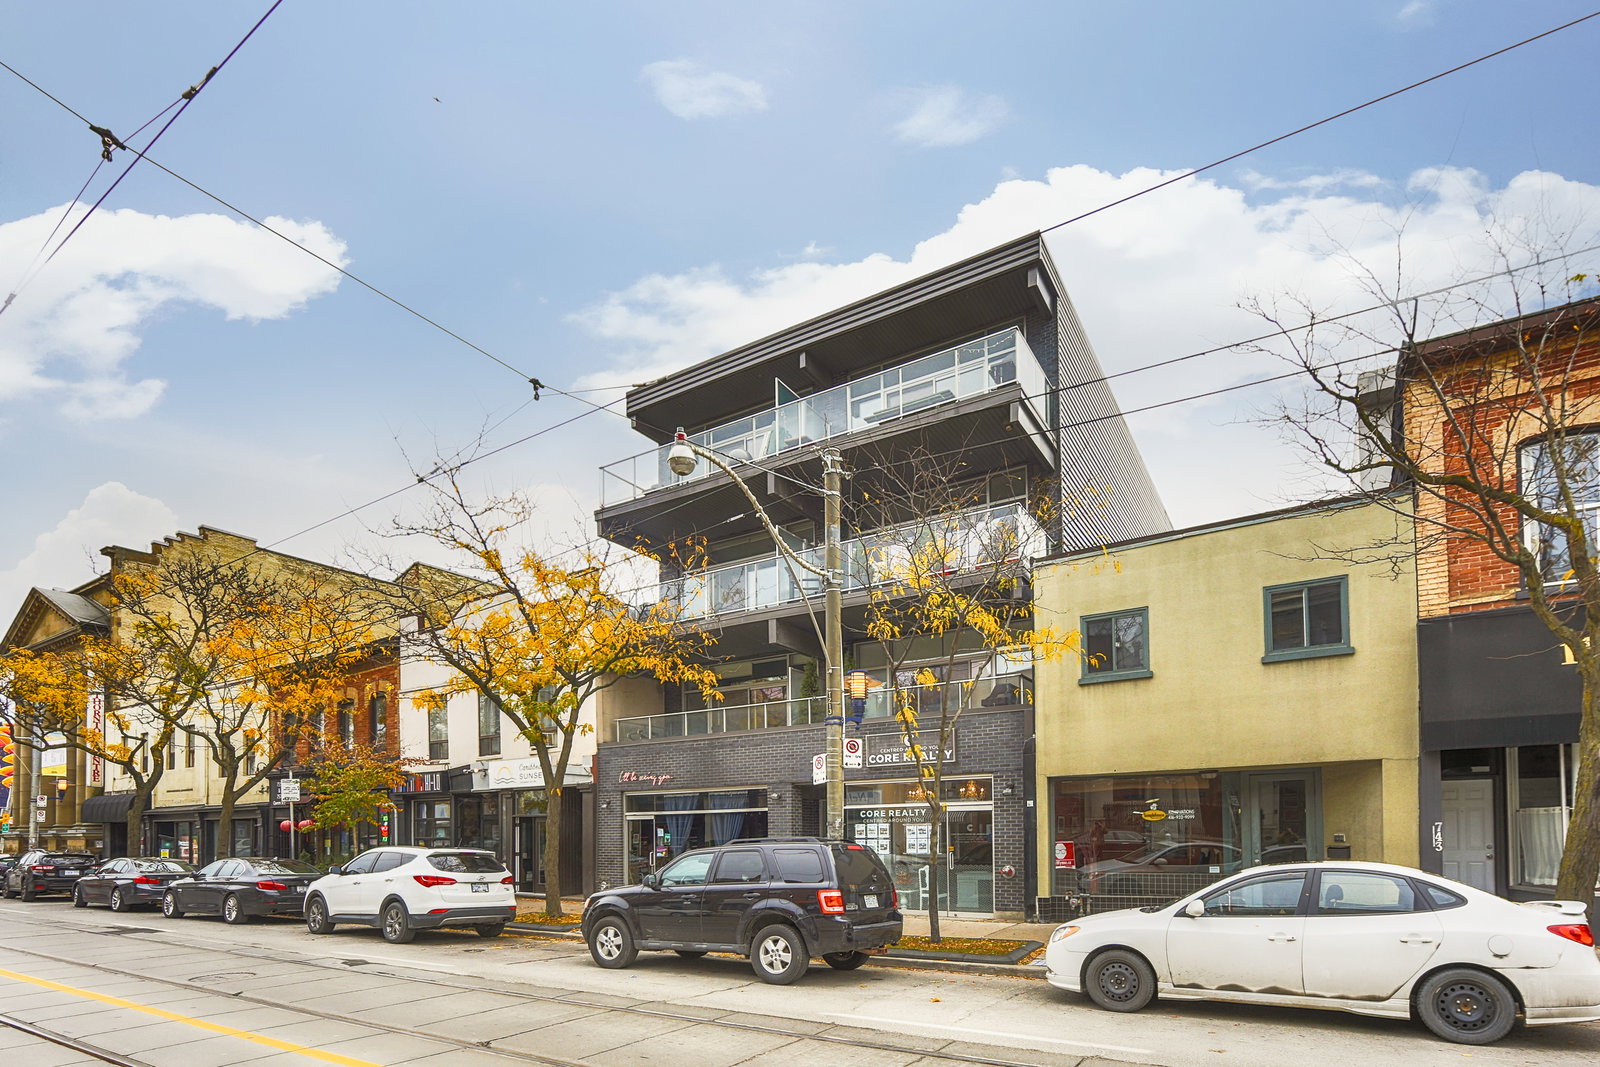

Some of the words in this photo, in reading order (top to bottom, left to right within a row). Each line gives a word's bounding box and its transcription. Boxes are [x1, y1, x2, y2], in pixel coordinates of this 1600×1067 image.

[868, 753, 900, 764] CORE
[519, 772, 543, 780] SUNSE
[860, 810, 886, 818] CORE
[888, 808, 927, 817] REALTY
[1434, 821, 1444, 852] 743
